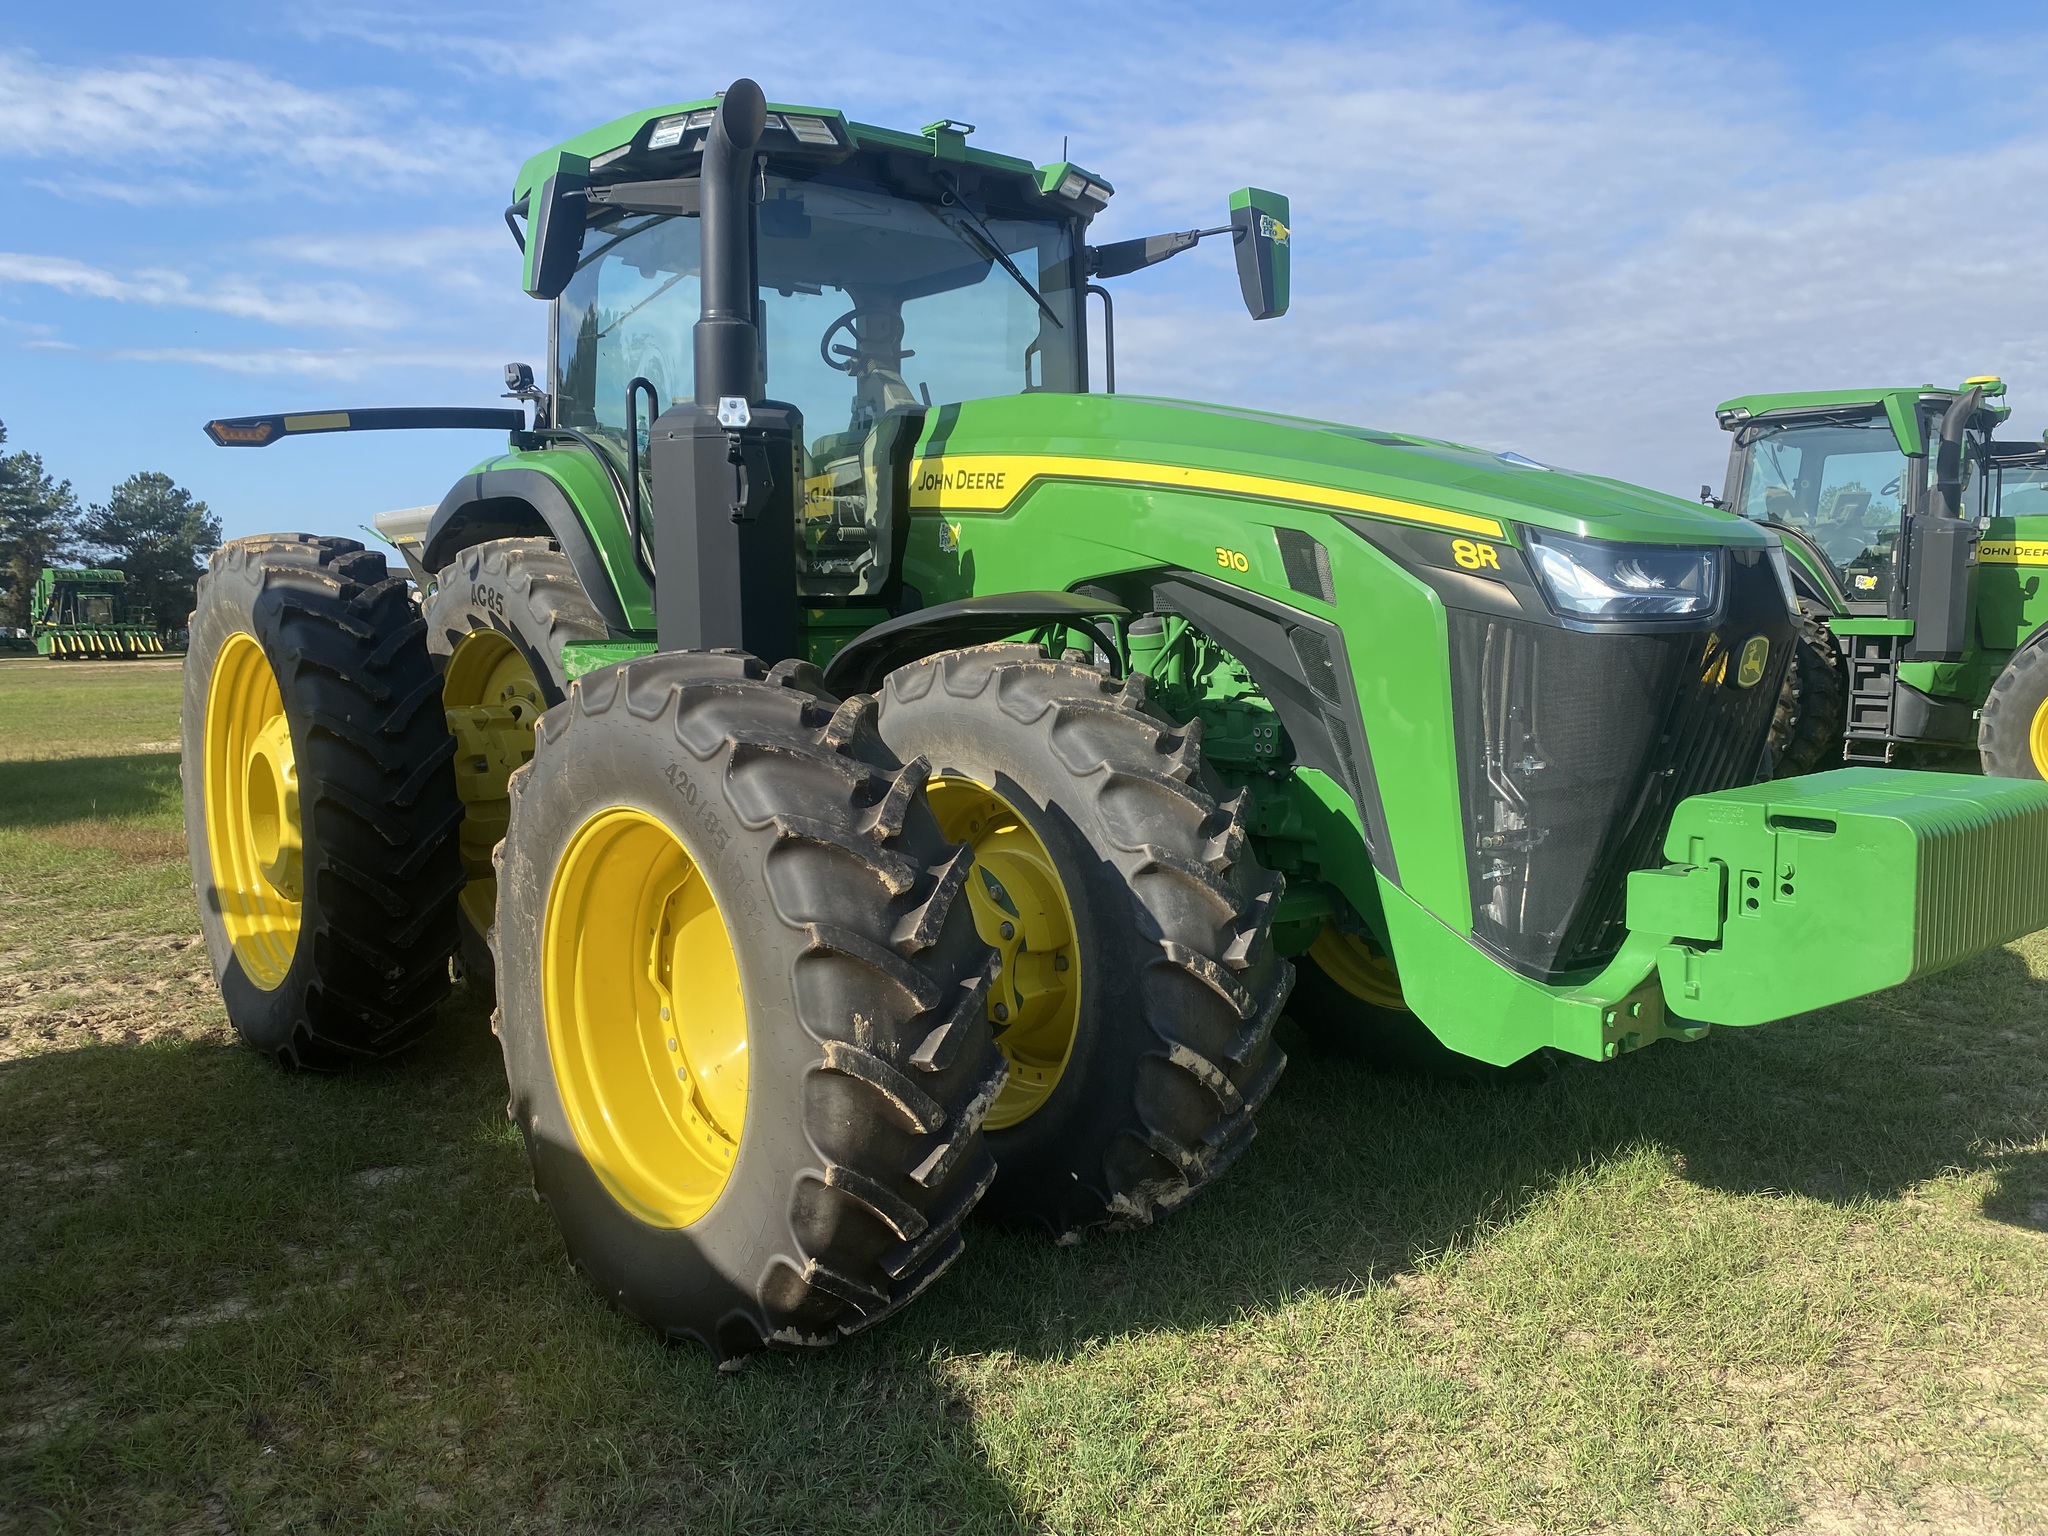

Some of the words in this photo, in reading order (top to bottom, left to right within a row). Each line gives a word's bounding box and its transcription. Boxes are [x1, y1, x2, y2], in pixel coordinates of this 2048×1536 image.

[918, 471, 954, 491] JOHN
[956, 470, 1006, 490] DEERE
[1215, 546, 1249, 573] 310
[1451, 538, 1501, 571] 8R
[471, 583, 504, 616] AC85
[664, 762, 731, 852] 420/85
